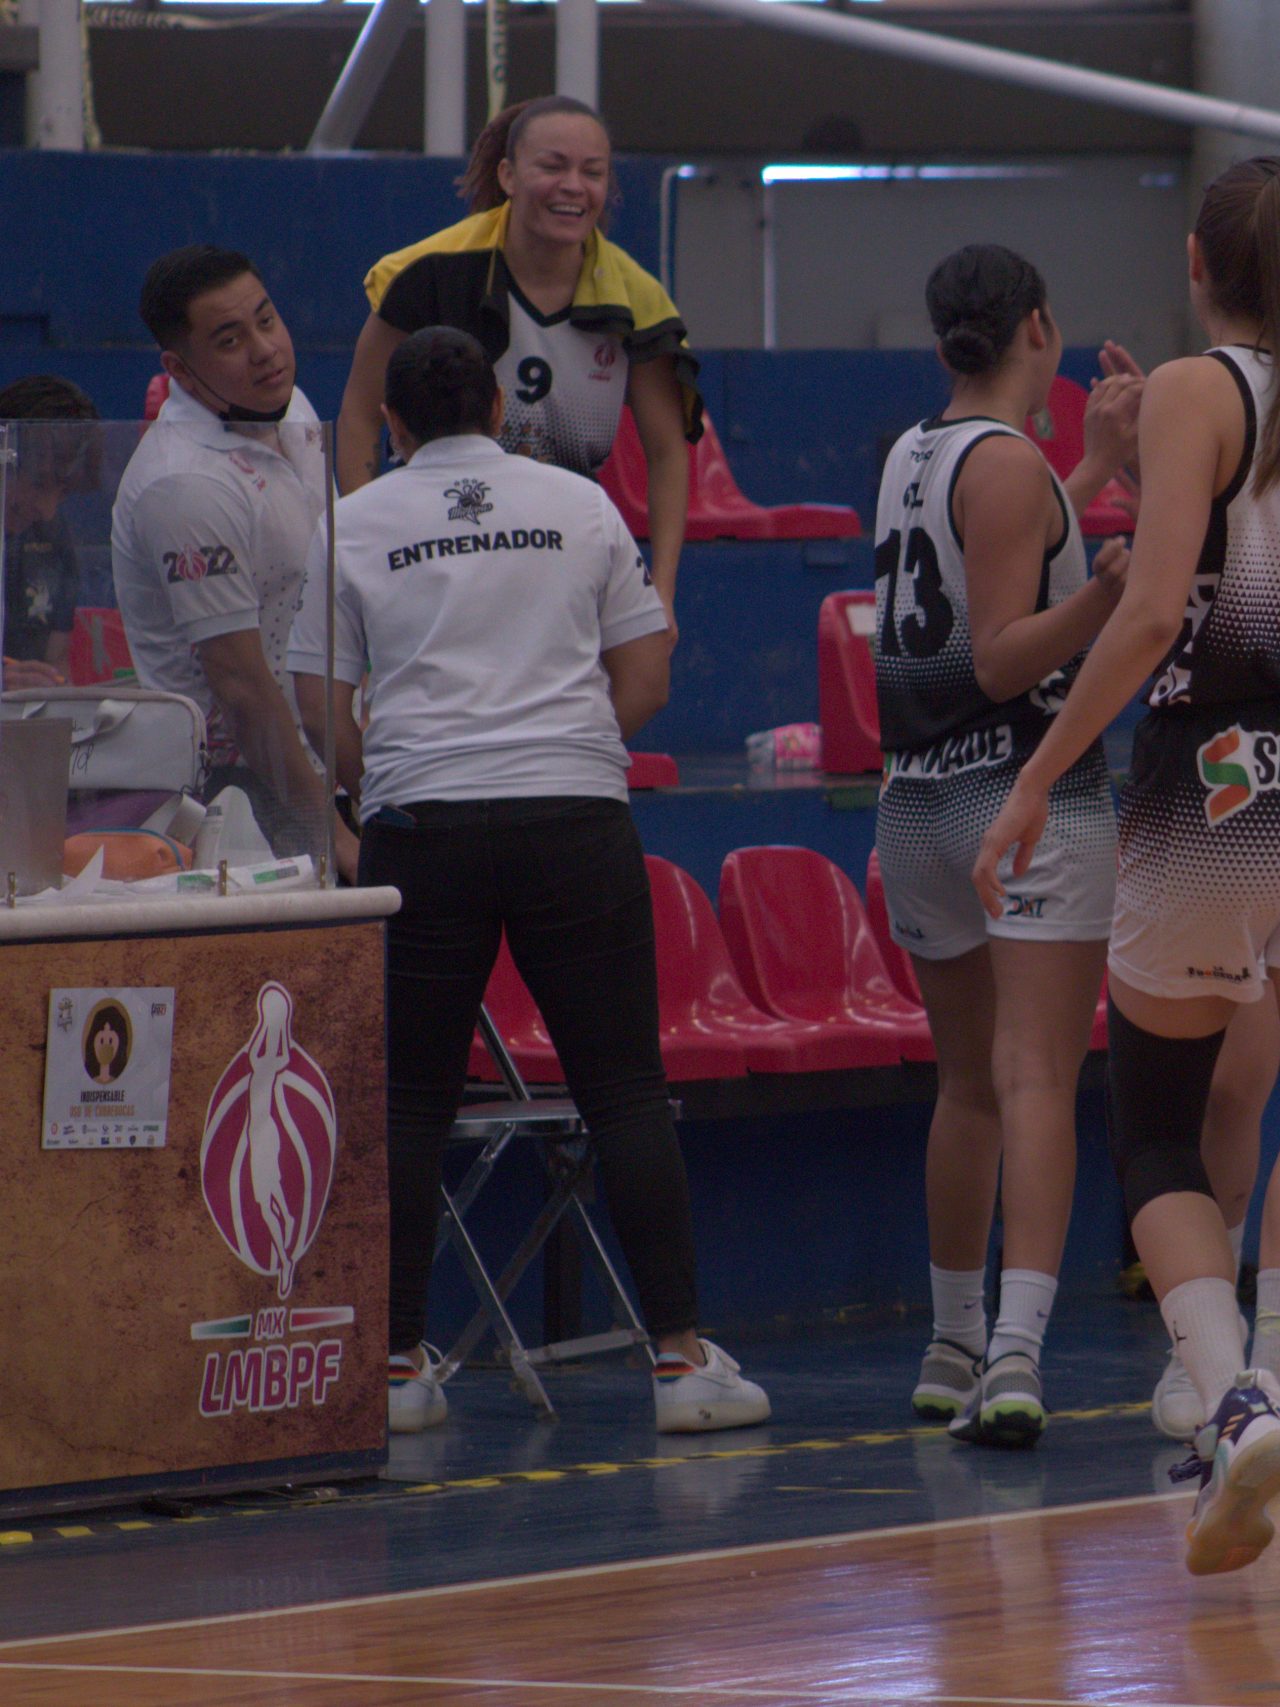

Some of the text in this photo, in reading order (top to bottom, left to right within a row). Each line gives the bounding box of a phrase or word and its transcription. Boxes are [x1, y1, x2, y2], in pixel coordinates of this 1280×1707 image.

[515, 355, 552, 404] 9
[387, 528, 564, 571] ENTRENADOR
[875, 526, 954, 657] 13
[255, 1306, 286, 1340] MX
[200, 1339, 342, 1417] LMBPF
